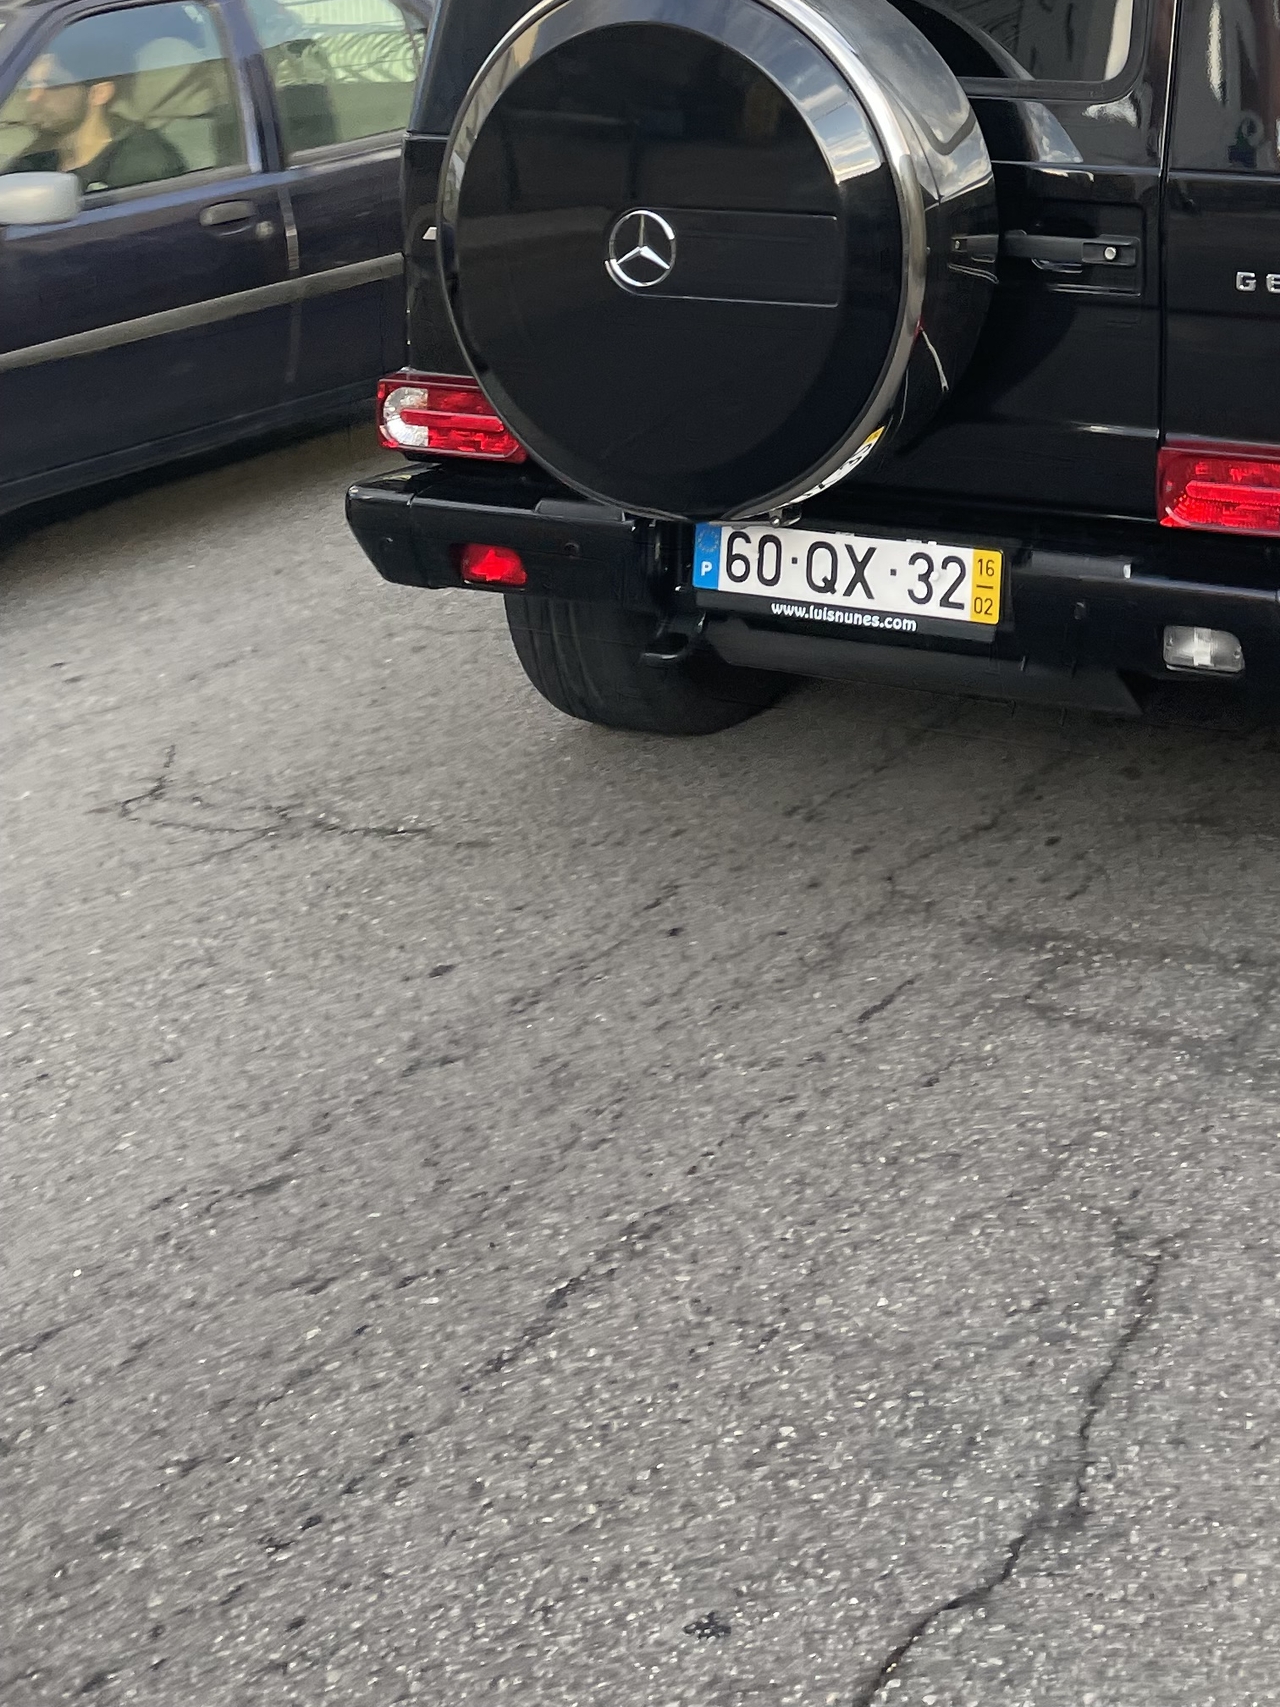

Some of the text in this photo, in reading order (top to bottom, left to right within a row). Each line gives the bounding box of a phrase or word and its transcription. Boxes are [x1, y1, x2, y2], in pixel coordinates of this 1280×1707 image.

[700, 560, 713, 577] P
[976, 558, 996, 578] 16
[770, 601, 918, 632] www.luisnunes.com
[973, 597, 994, 617] 02
